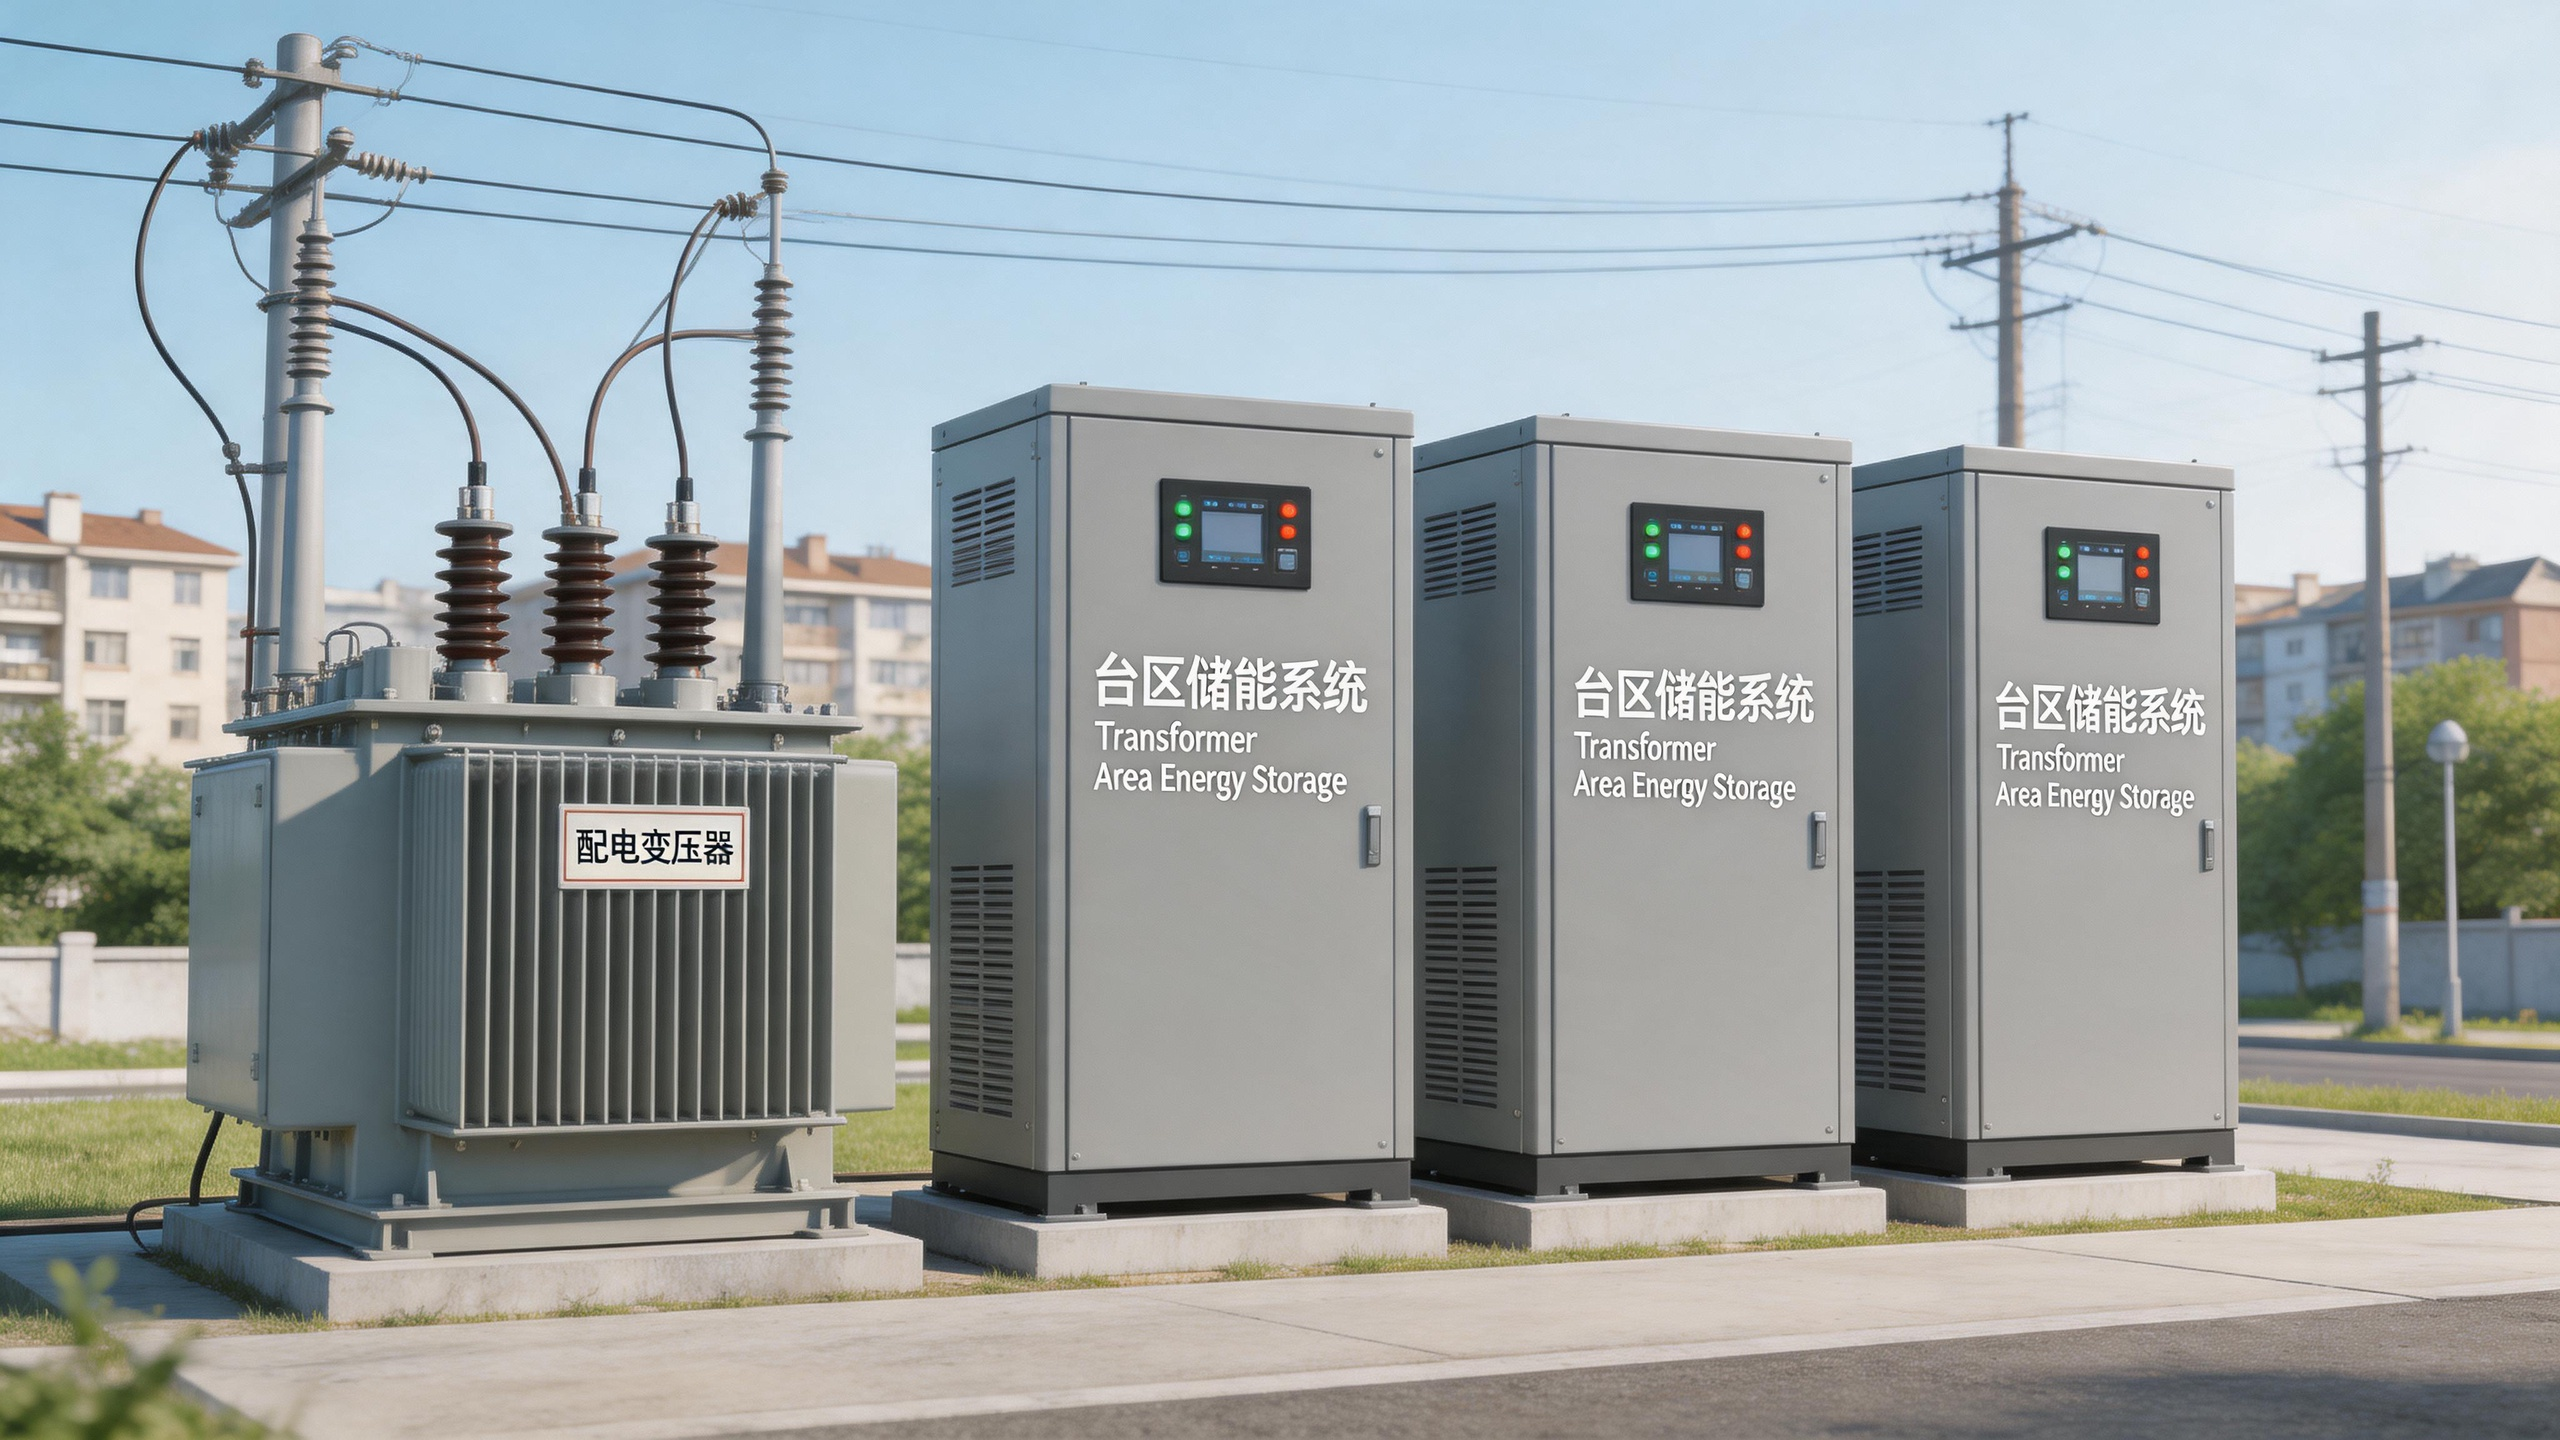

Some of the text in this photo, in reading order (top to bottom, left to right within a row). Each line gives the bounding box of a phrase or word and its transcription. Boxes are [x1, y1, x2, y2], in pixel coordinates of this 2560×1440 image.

[1095, 651, 1368, 714] 台区储能系统
[1574, 665, 1815, 724] 台区储能系统
[1995, 680, 2207, 736] 台区储能系统
[1094, 720, 1258, 754] Transformer
[1573, 730, 1717, 762] Transformer
[1996, 742, 2126, 773] Transformer
[1093, 761, 1348, 803] Area Energy Storage
[1573, 769, 1796, 809] Area Energy Storage
[1995, 781, 2195, 817] Area Energy Storage
[575, 827, 734, 866] 配电变压器
